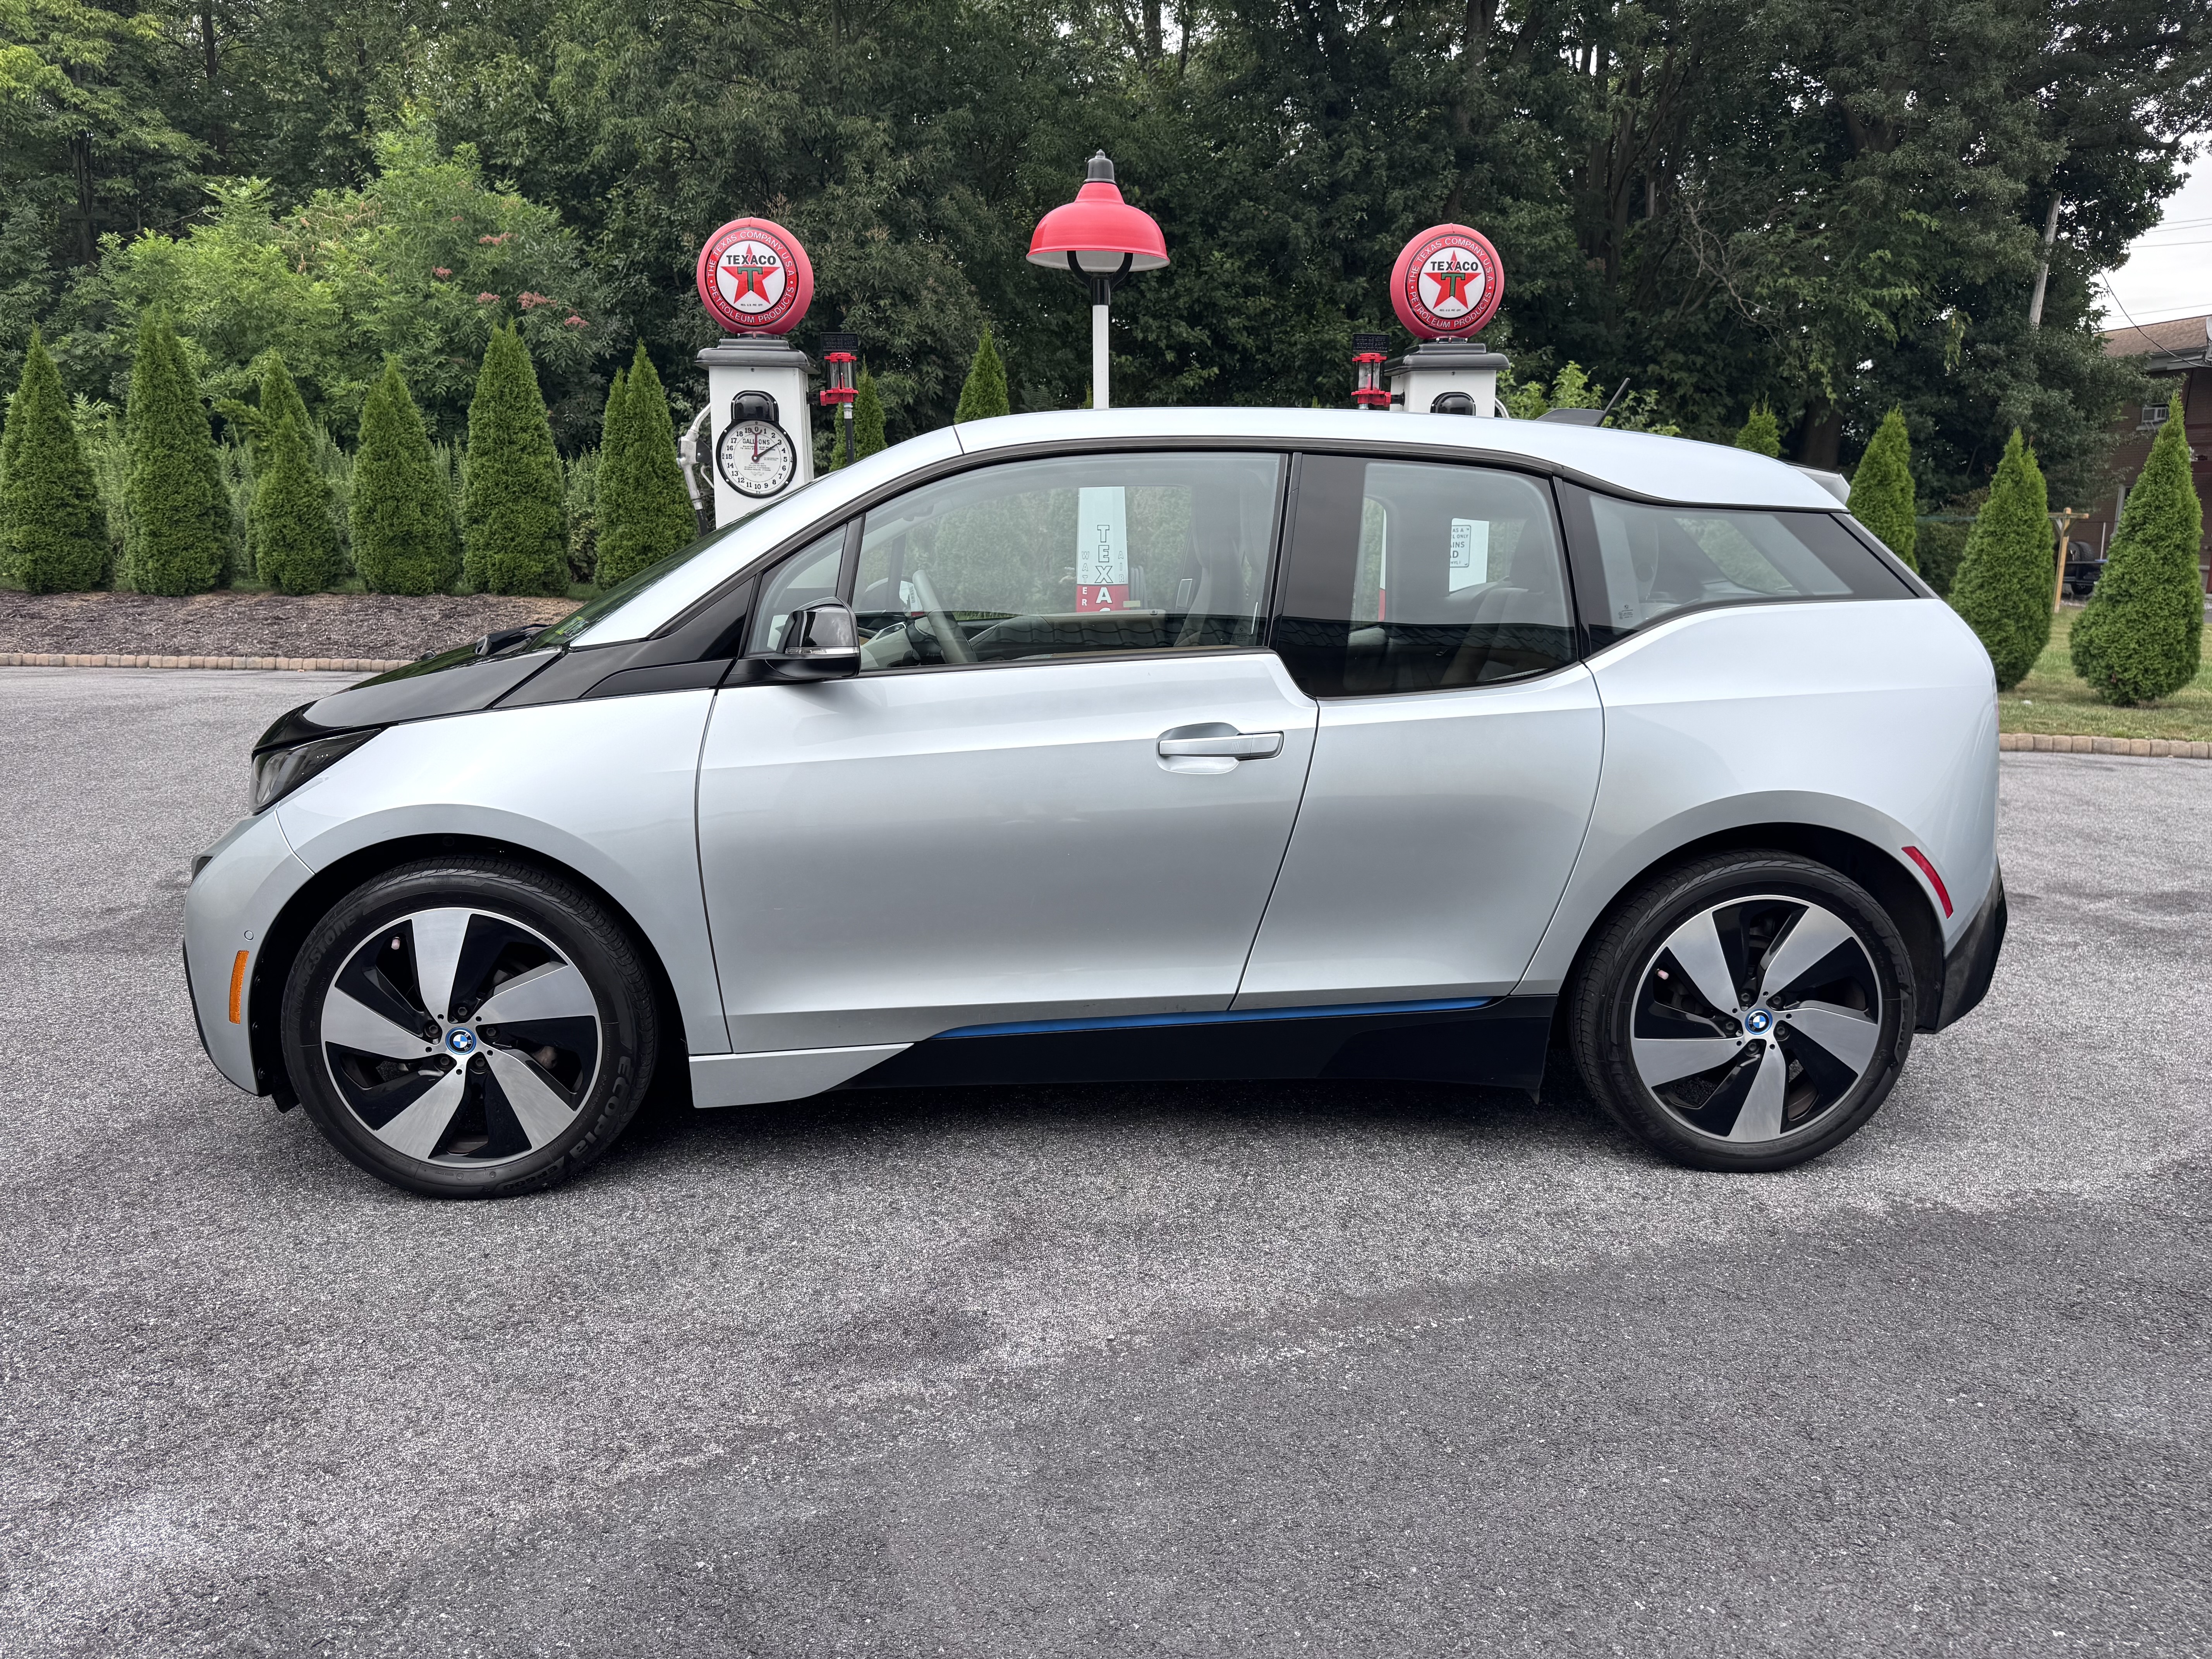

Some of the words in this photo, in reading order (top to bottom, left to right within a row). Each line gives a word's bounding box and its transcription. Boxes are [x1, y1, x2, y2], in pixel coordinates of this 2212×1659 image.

[708, 259, 716, 277] THE
[713, 234, 737, 256] TEXAS
[740, 231, 783, 250] COMPANY
[726, 255, 776, 265] TEXACO
[1409, 265, 1419, 283] THE
[1416, 241, 1442, 263] TEXAS
[1445, 238, 1484, 257] COMPANY
[1431, 261, 1478, 271] TEXACO
[710, 286, 755, 323] PETROLEUM
[758, 287, 794, 323] PRODUCTS
[1410, 292, 1450, 328] PETROLEUM
[1454, 293, 1491, 328] PRODUCTS
[1094, 525, 1113, 611] TEXA
[503, 1165, 558, 1190] EP600
